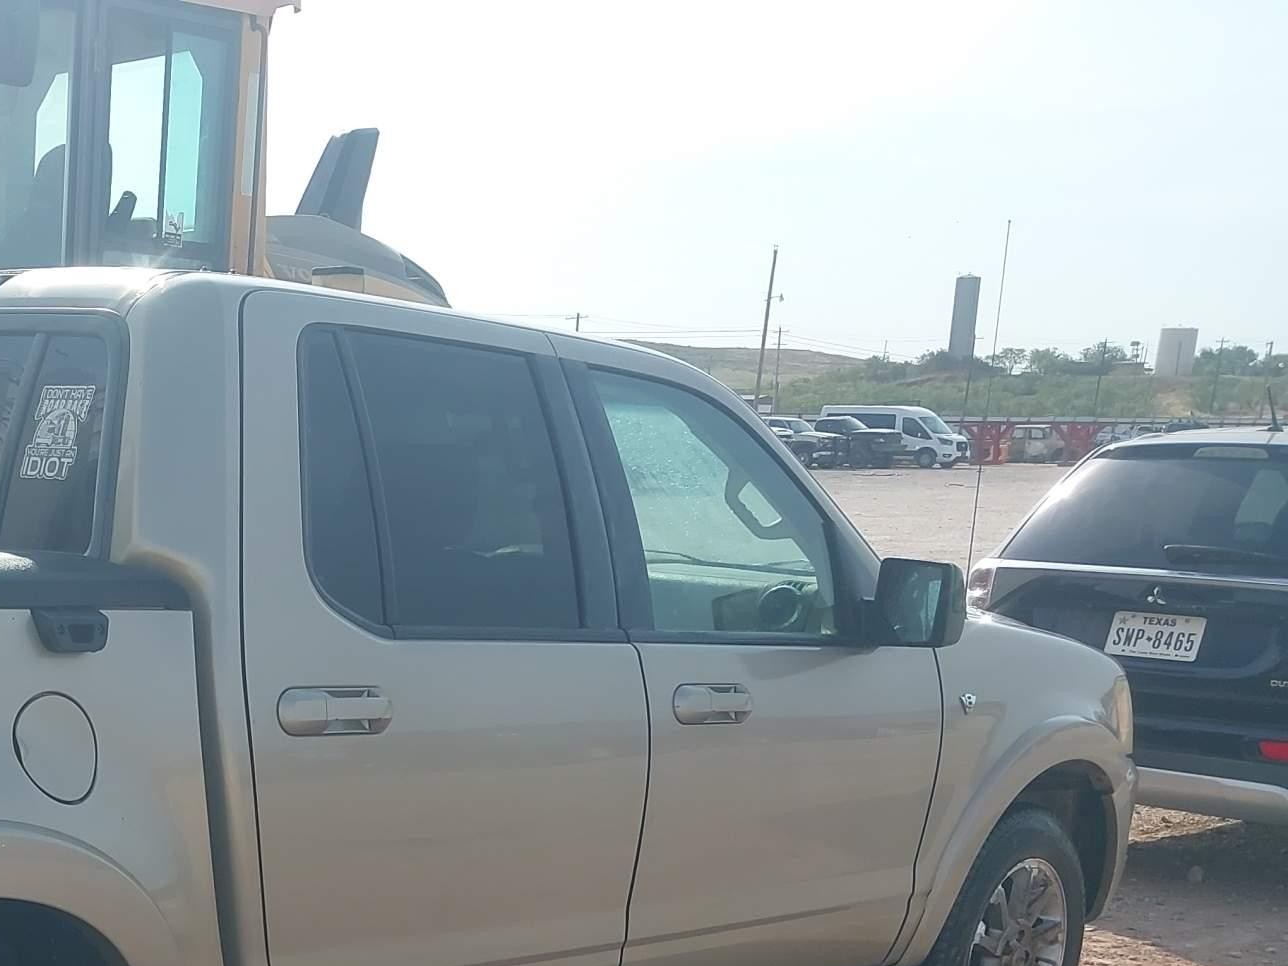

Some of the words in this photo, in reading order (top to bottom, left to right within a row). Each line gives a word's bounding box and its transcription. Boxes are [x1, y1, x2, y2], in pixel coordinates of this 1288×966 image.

[70, 389, 93, 399] HAVE
[23, 457, 73, 477] IDIOT
[1143, 616, 1177, 627] TEXAS
